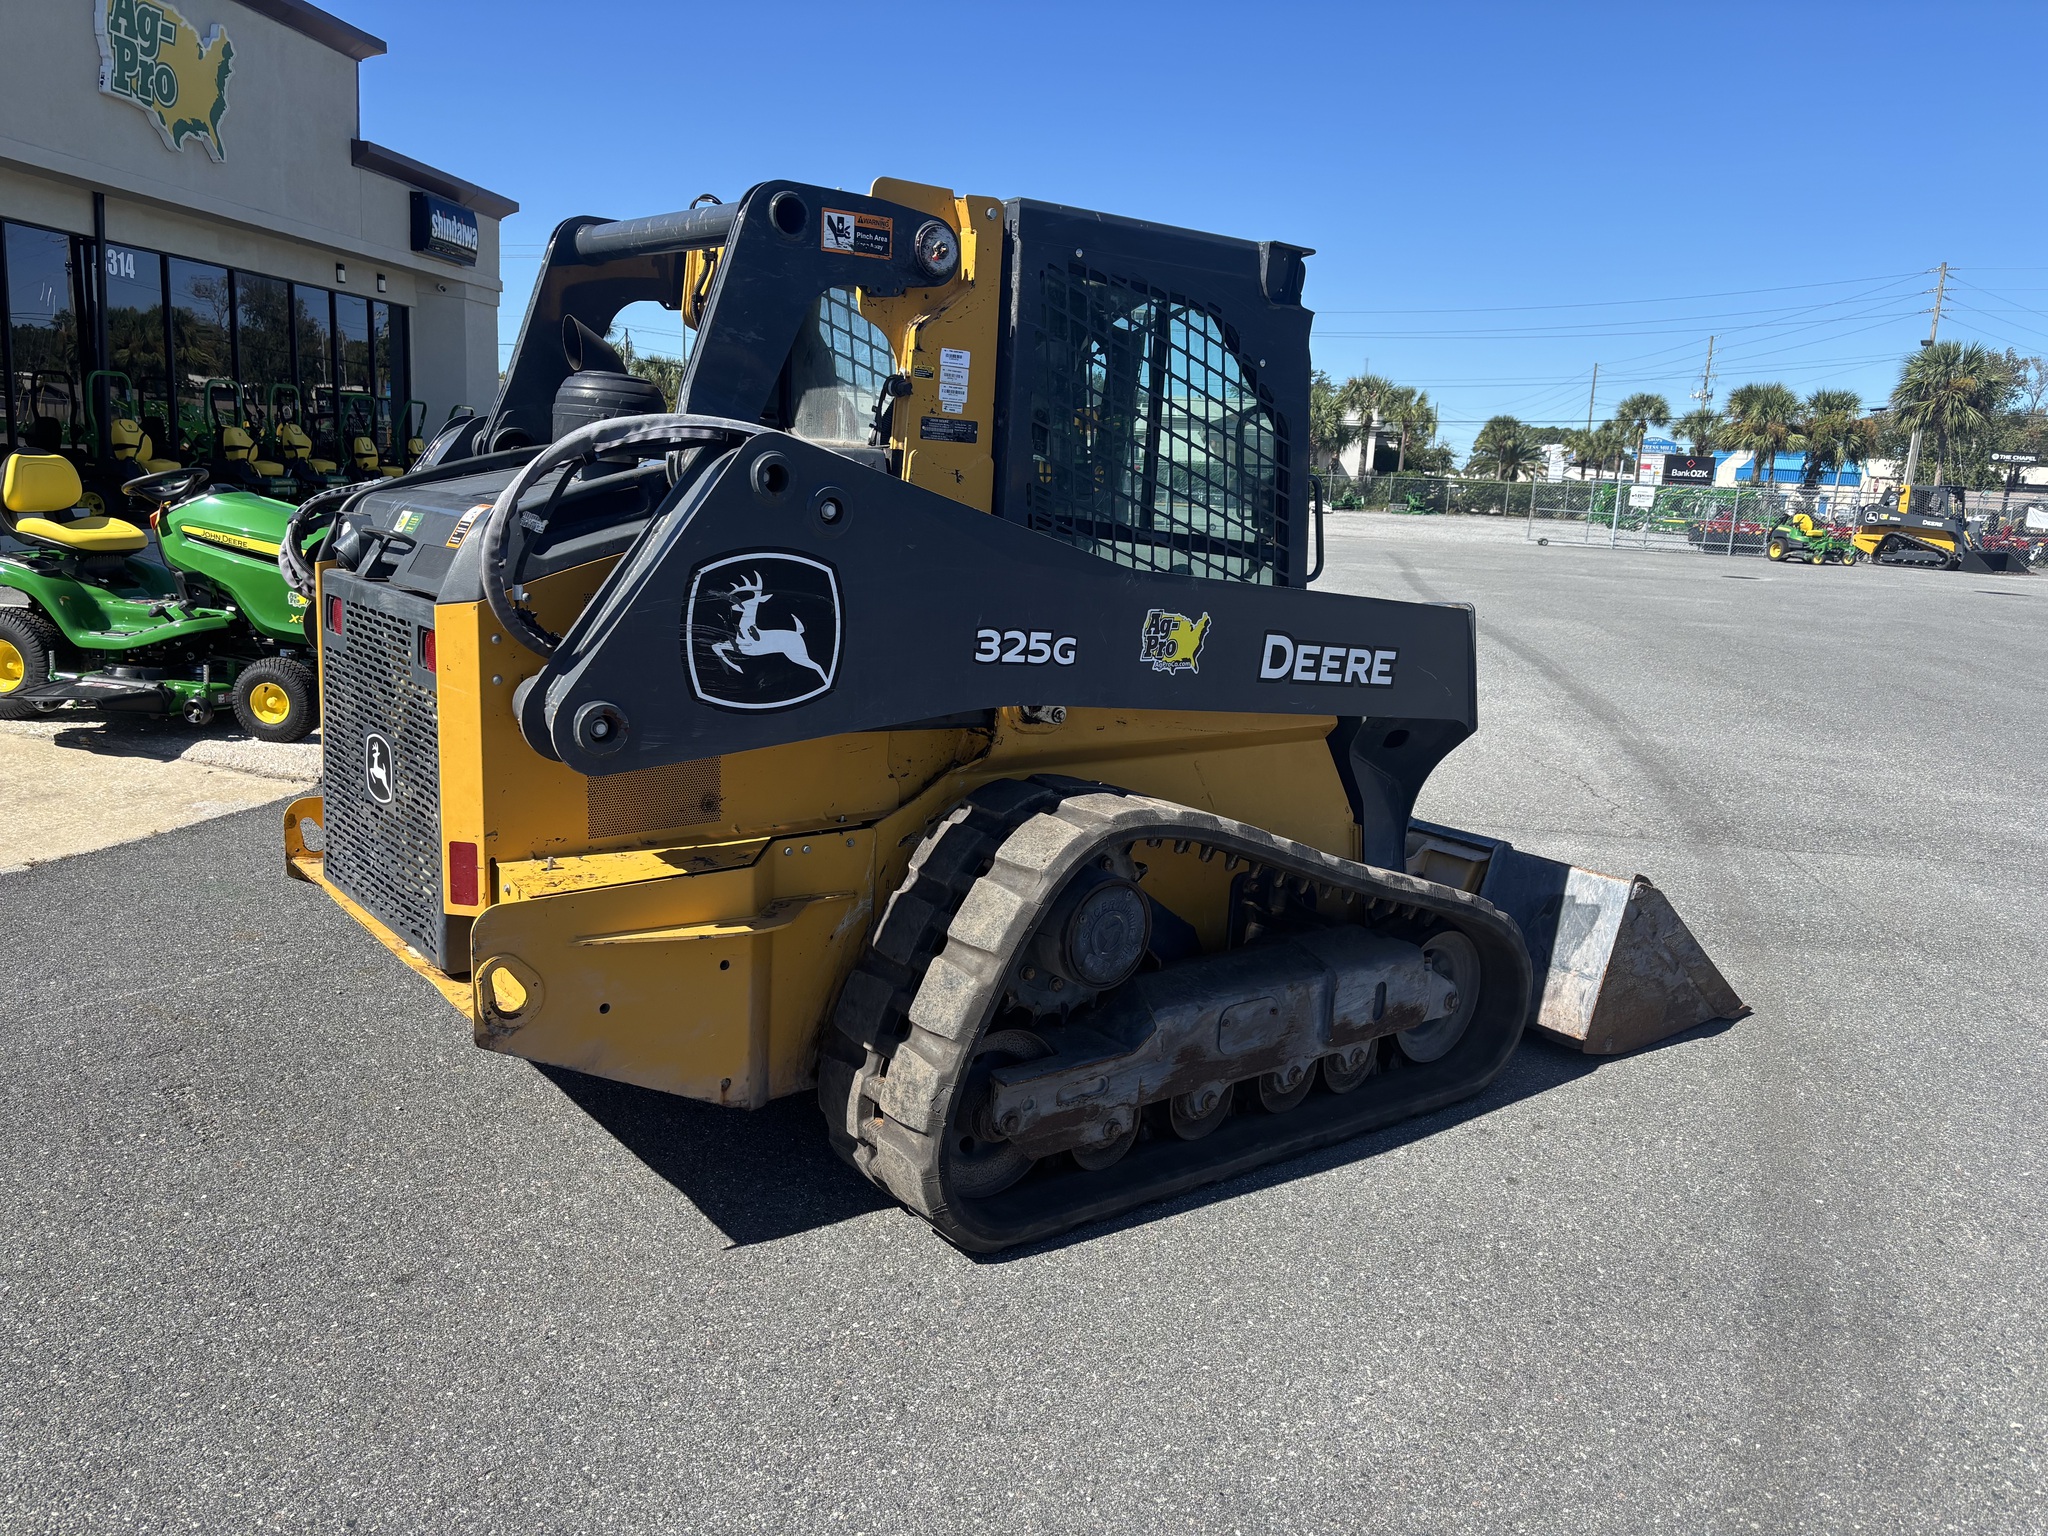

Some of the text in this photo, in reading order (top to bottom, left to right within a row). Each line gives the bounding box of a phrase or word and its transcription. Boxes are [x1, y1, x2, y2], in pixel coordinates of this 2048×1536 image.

[108, 0, 176, 59] Ag-
[111, 33, 178, 107] Pro
[431, 209, 478, 251] shindaiwa
[856, 231, 888, 243] Pinch Area
[863, 218, 890, 228] WARNING
[105, 248, 135, 279] 314
[201, 530, 248, 548] JOHN DEERE
[1145, 612, 1179, 640] Ag-
[975, 629, 1077, 665] 325G
[1143, 636, 1178, 658] Pro
[1260, 634, 1397, 685] DEERE
[1155, 661, 1191, 669] AgProCo.com
